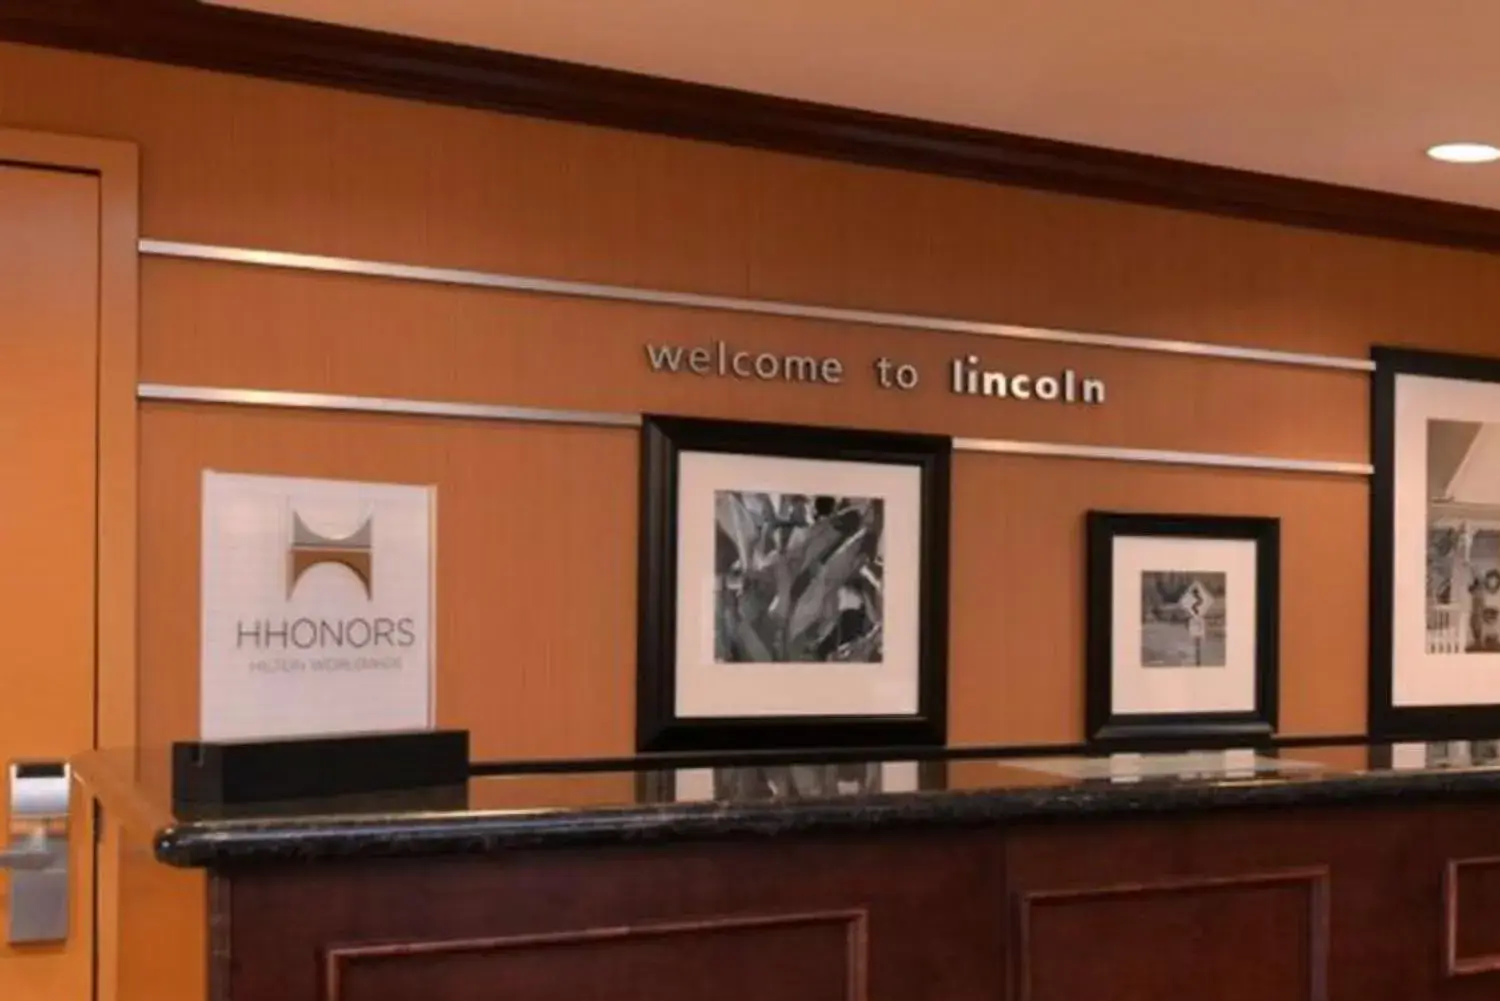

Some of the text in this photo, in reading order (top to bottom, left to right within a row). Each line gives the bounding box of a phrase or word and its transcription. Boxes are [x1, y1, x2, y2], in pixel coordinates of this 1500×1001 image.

[646, 341, 1106, 403] welcome to lincoln
[237, 617, 416, 649] HHONORS
